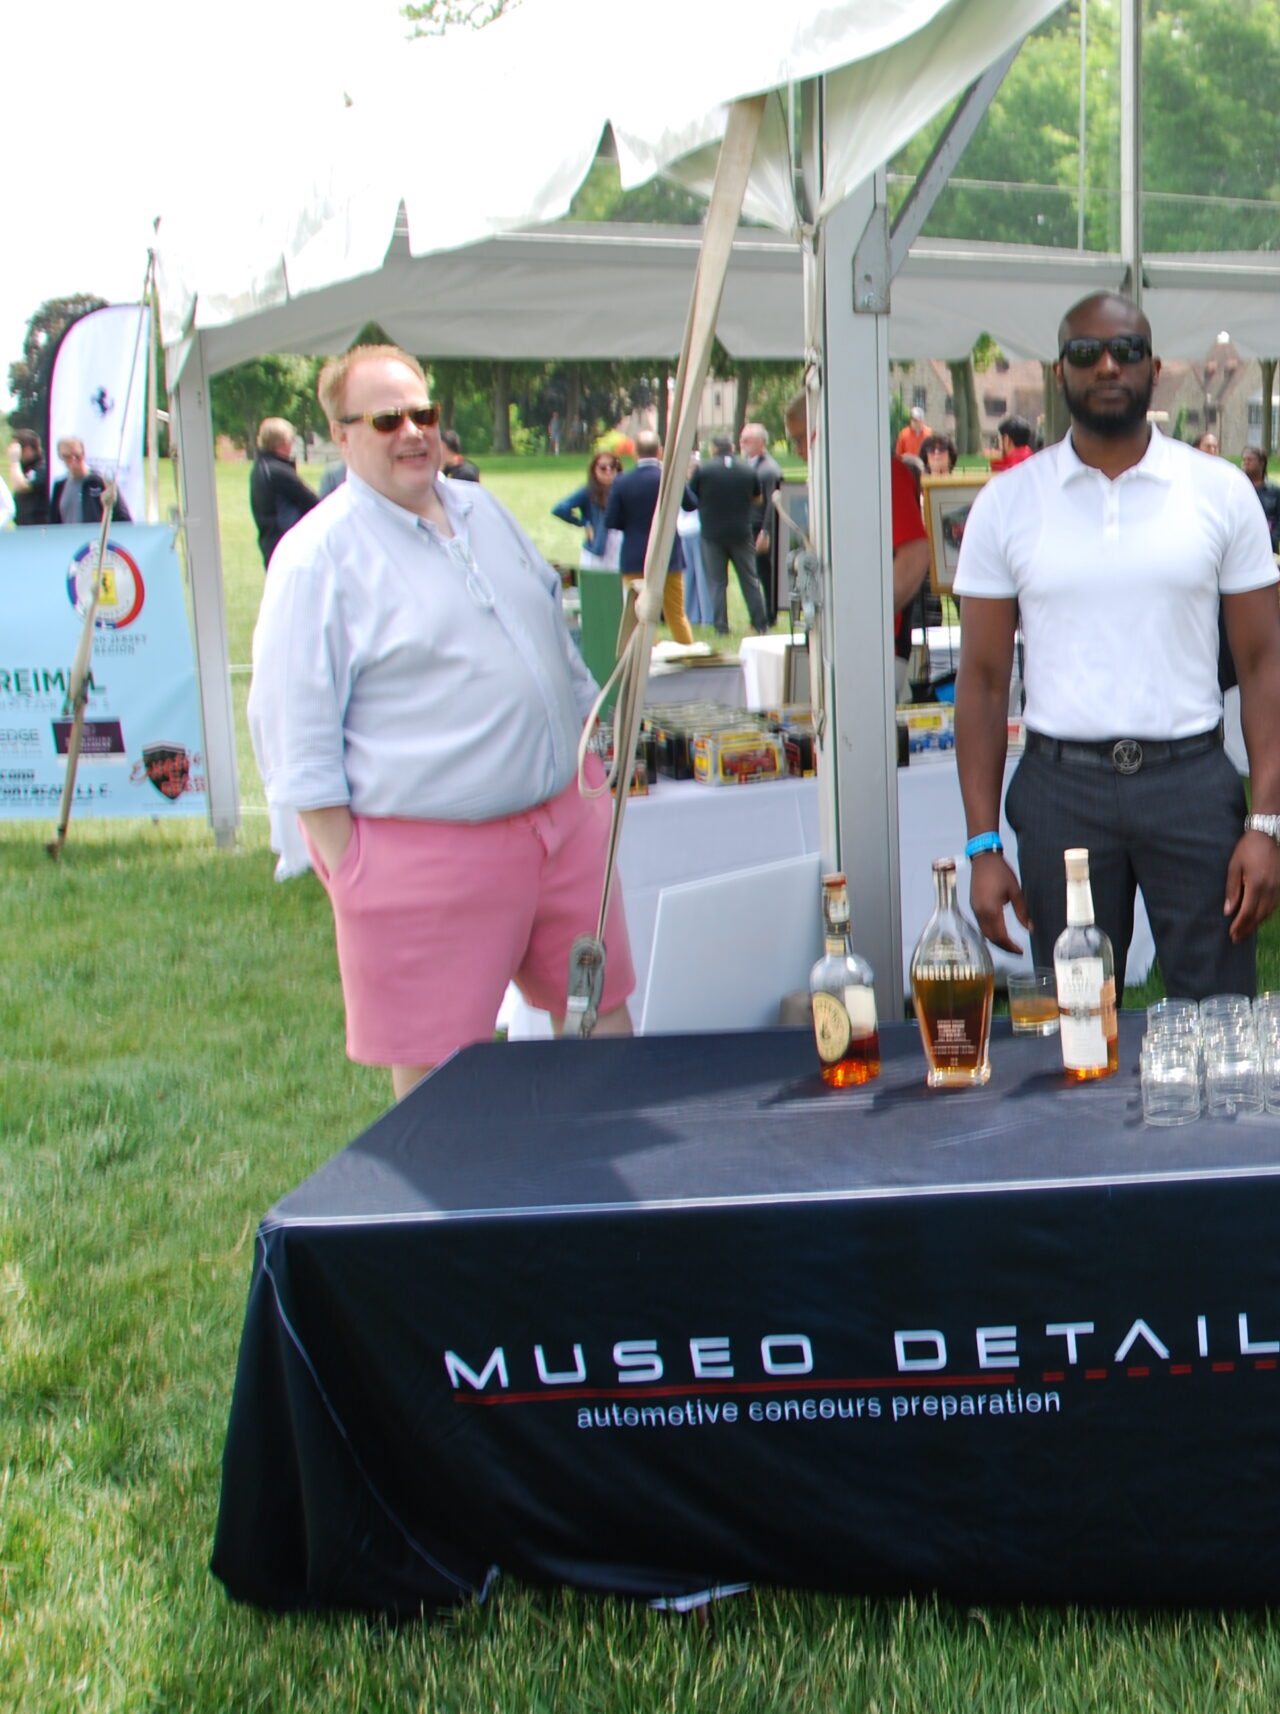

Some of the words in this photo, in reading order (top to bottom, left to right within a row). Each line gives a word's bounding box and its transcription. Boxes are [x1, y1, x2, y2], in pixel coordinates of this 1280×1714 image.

[445, 1333, 814, 1391] MUSEO
[893, 1312, 1280, 1373] DETAIL
[576, 1397, 739, 1429] automotive
[749, 1396, 881, 1423] concours
[891, 1386, 1062, 1420] preparation
